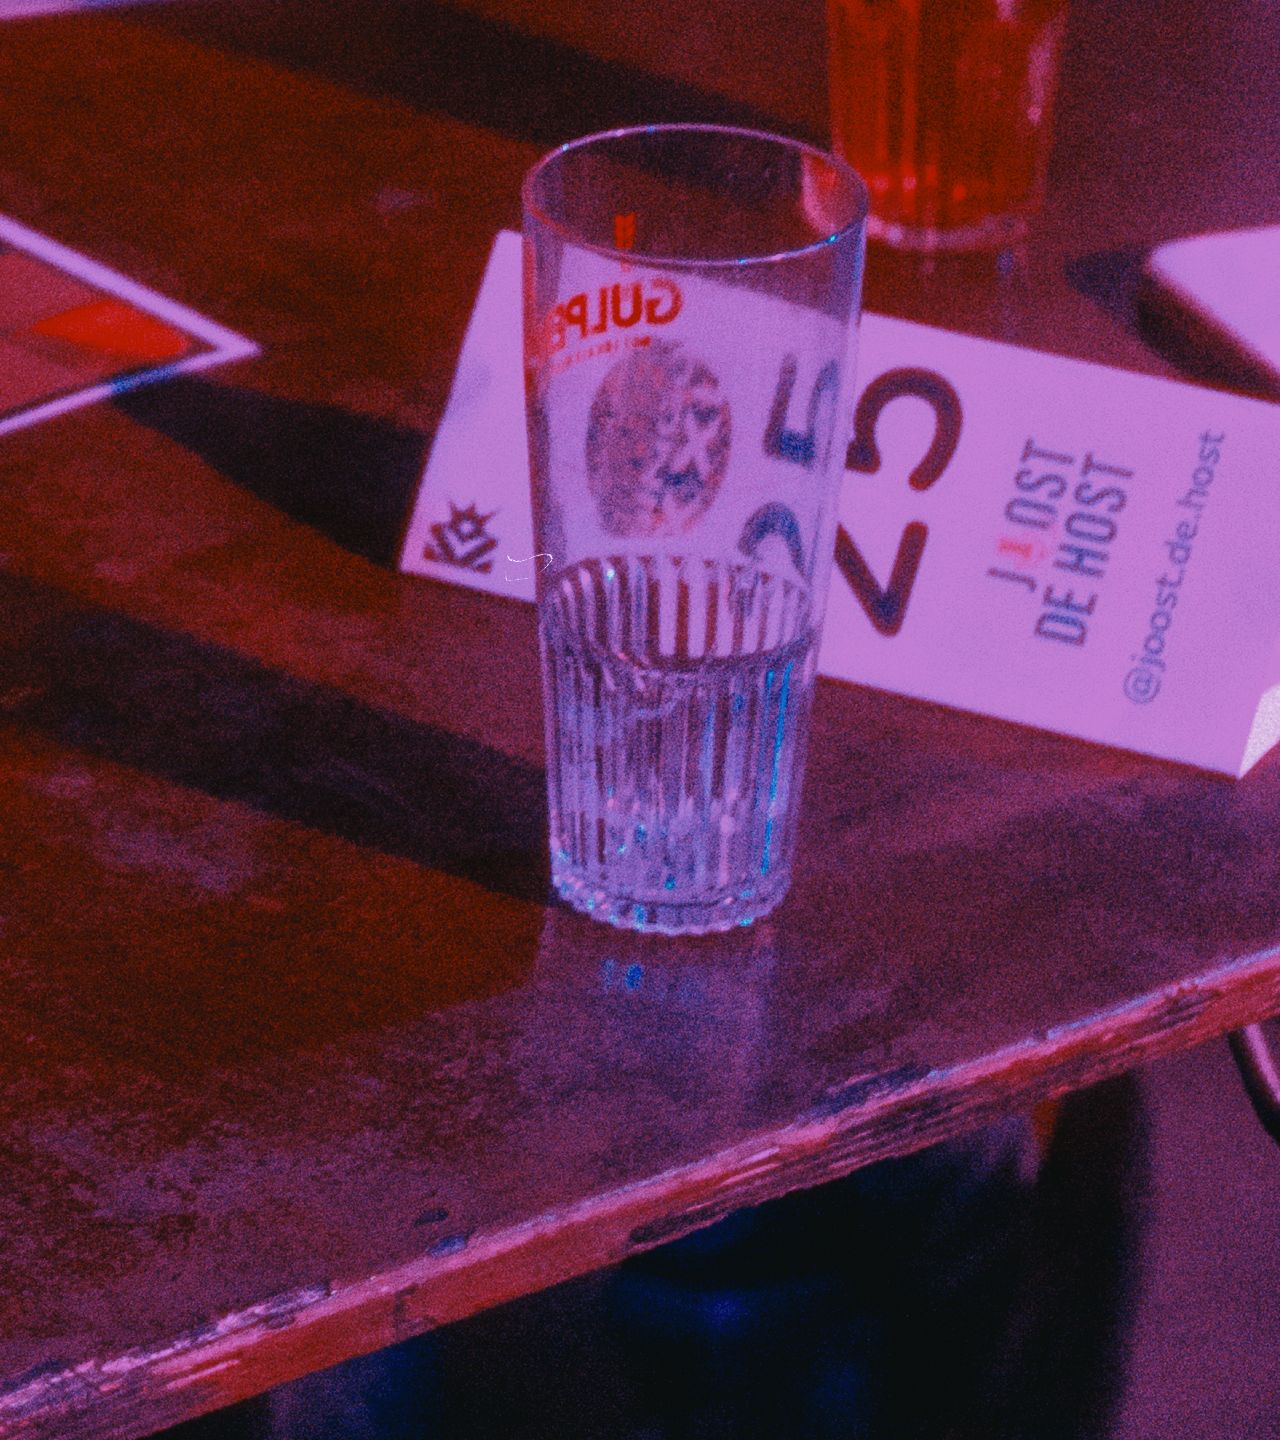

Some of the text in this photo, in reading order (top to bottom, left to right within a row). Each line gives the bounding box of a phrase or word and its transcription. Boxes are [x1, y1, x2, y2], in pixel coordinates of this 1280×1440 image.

[1034, 451, 1136, 648] DE HOST
[1122, 427, 1226, 705] @joost.de.host
